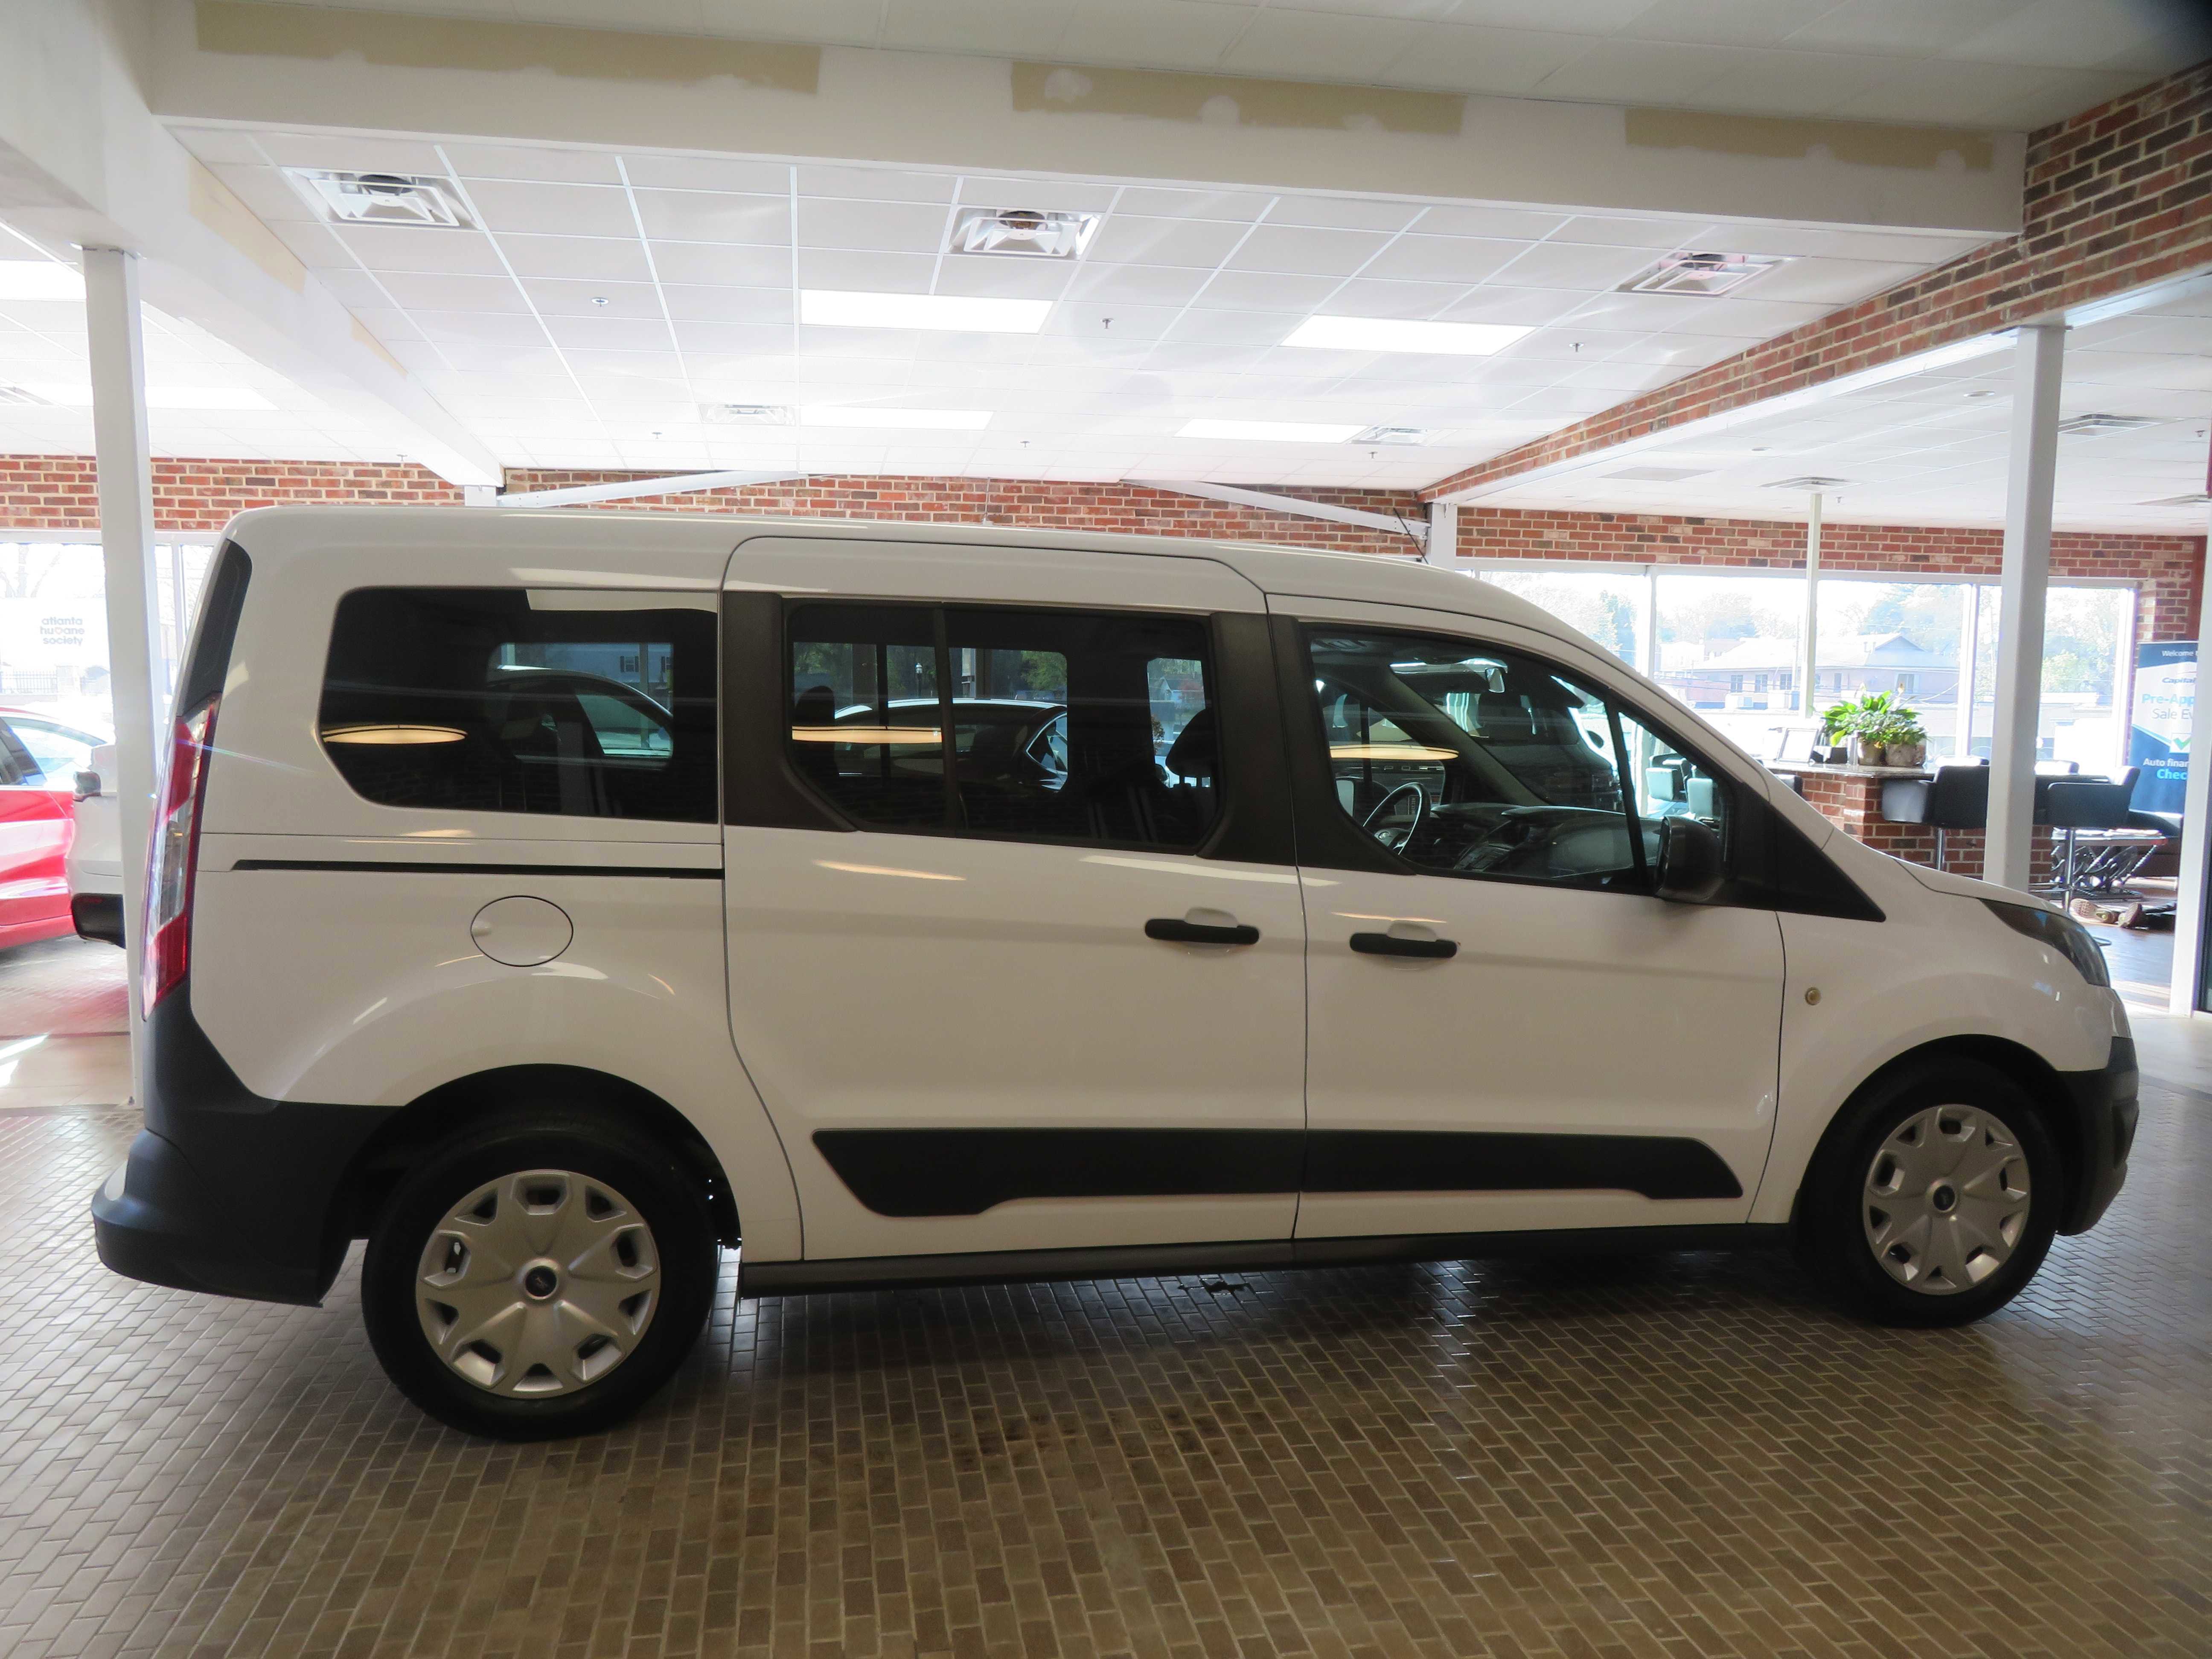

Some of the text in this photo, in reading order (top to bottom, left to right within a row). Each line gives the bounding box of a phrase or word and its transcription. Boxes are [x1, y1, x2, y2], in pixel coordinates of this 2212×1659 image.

[41, 617, 83, 625] atlanta
[43, 636, 83, 646] society
[2152, 708, 2177, 719] Sale
[2143, 758, 2165, 766] Auto
[2157, 768, 2188, 780] Chec
